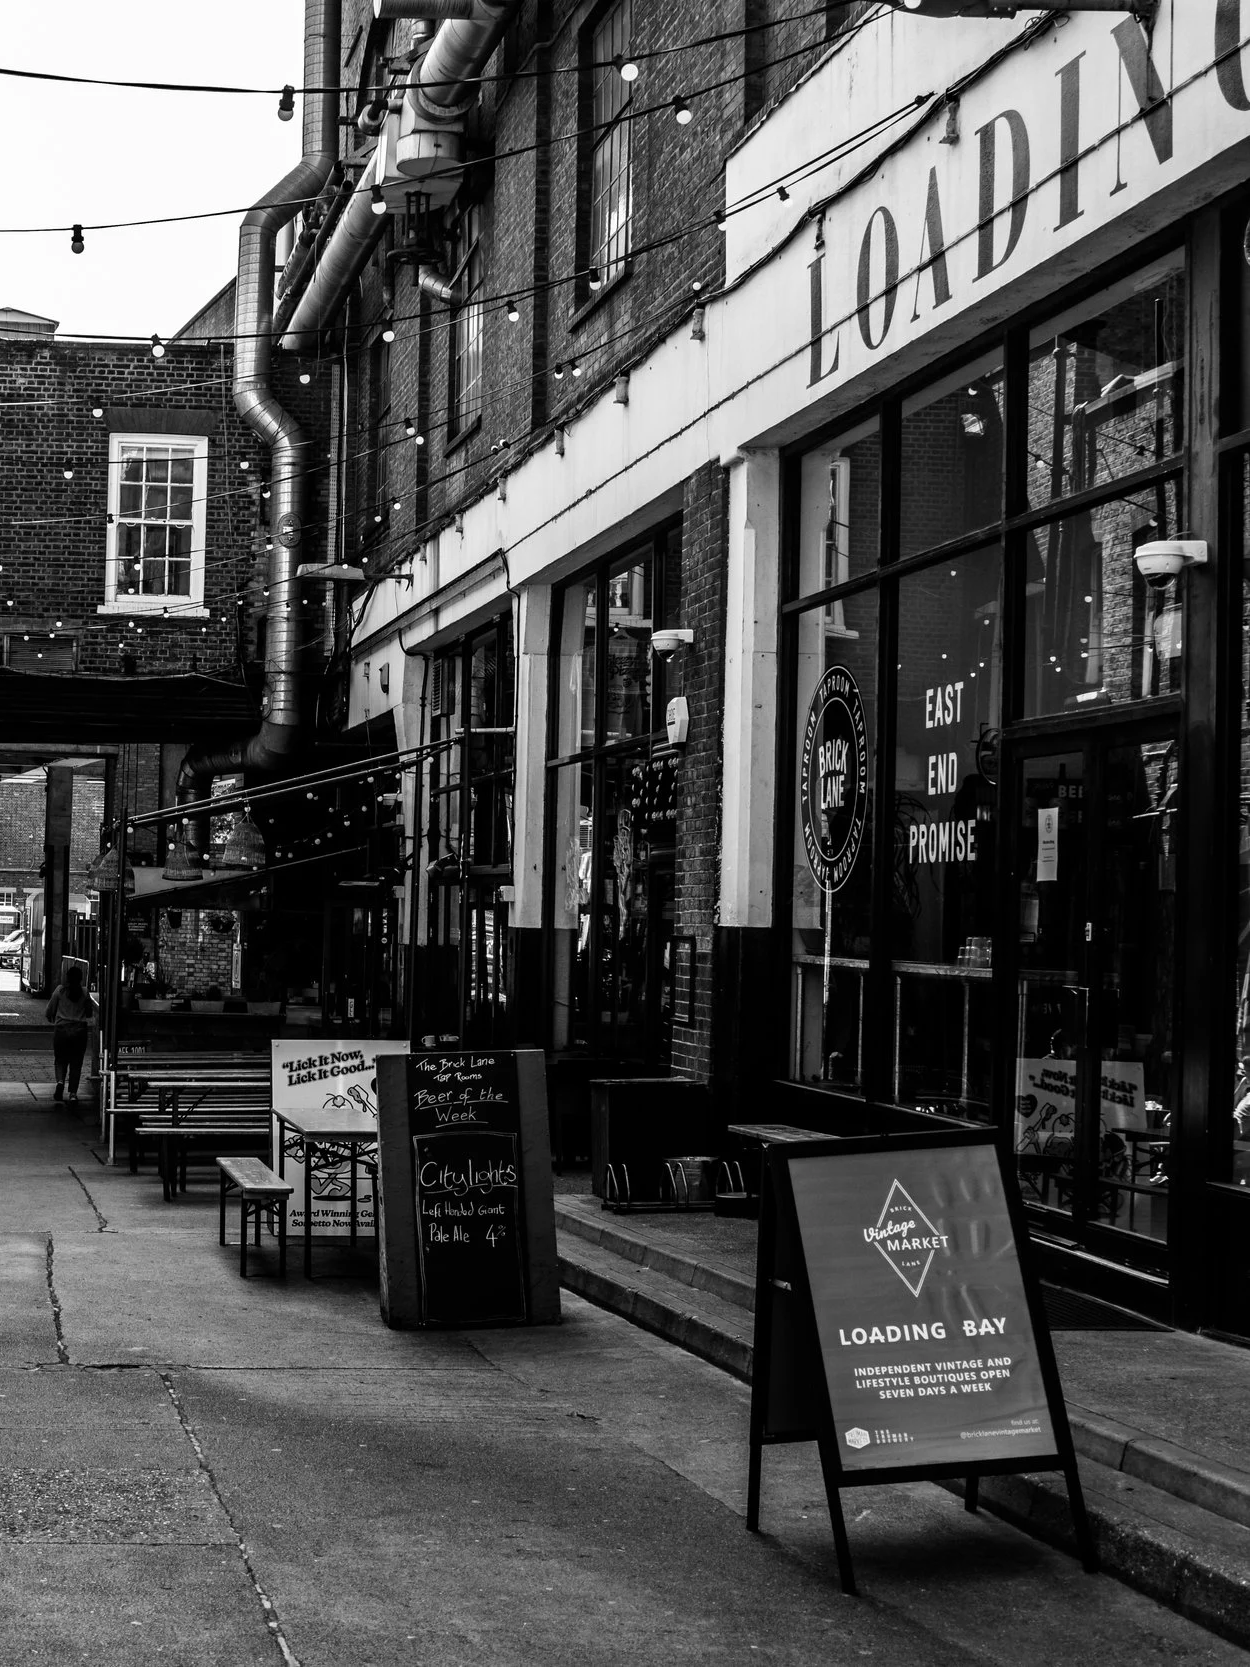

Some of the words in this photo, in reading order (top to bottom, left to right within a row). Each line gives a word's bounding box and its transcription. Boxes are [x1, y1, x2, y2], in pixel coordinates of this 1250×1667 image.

[819, 675, 850, 704] TAPROOM
[925, 681, 964, 729] EAST
[853, 698, 867, 795] TAPROOM
[819, 738, 849, 778] BRICK
[928, 752, 958, 796] END
[821, 775, 845, 810] LANE
[833, 817, 862, 883] TAPROOM
[909, 819, 976, 864] PROMISE
[318, 1055, 330, 1067] It
[330, 1050, 364, 1064] Now,
[416, 1059, 437, 1072] The
[439, 1057, 465, 1073] Brick
[471, 1056, 495, 1068] Lane
[287, 1071, 318, 1086] Lick
[318, 1068, 329, 1080] It
[454, 1072, 482, 1081] Rooms
[414, 1089, 453, 1110] Beer
[459, 1087, 472, 1106] of
[480, 1087, 503, 1101] the
[436, 1106, 477, 1122] Week
[290, 1209, 320, 1218] Awrd
[422, 1200, 442, 1217] Left
[478, 1204, 505, 1216] Giant
[889, 1205, 913, 1213] BRICK
[429, 1223, 450, 1243] Pale
[453, 1225, 470, 1242] Ale
[486, 1224, 506, 1248] 4%
[863, 1219, 916, 1243] Vintage
[887, 1235, 949, 1252] MARKET
[838, 1321, 947, 1346] LOADING
[962, 1317, 1007, 1337] BAY
[854, 1362, 932, 1377] INDEPENDENT
[935, 1358, 984, 1372] VINTAGE
[987, 1356, 1012, 1367] AND
[856, 1374, 911, 1389] LIFESTYLE
[914, 1371, 977, 1385] BOUTIQUES
[980, 1369, 1011, 1380] OPEN
[879, 1388, 915, 1400] SEVEN
[918, 1386, 947, 1397] DAYS
[949, 1385, 958, 1395] A
[961, 1382, 992, 1393] WEEK
